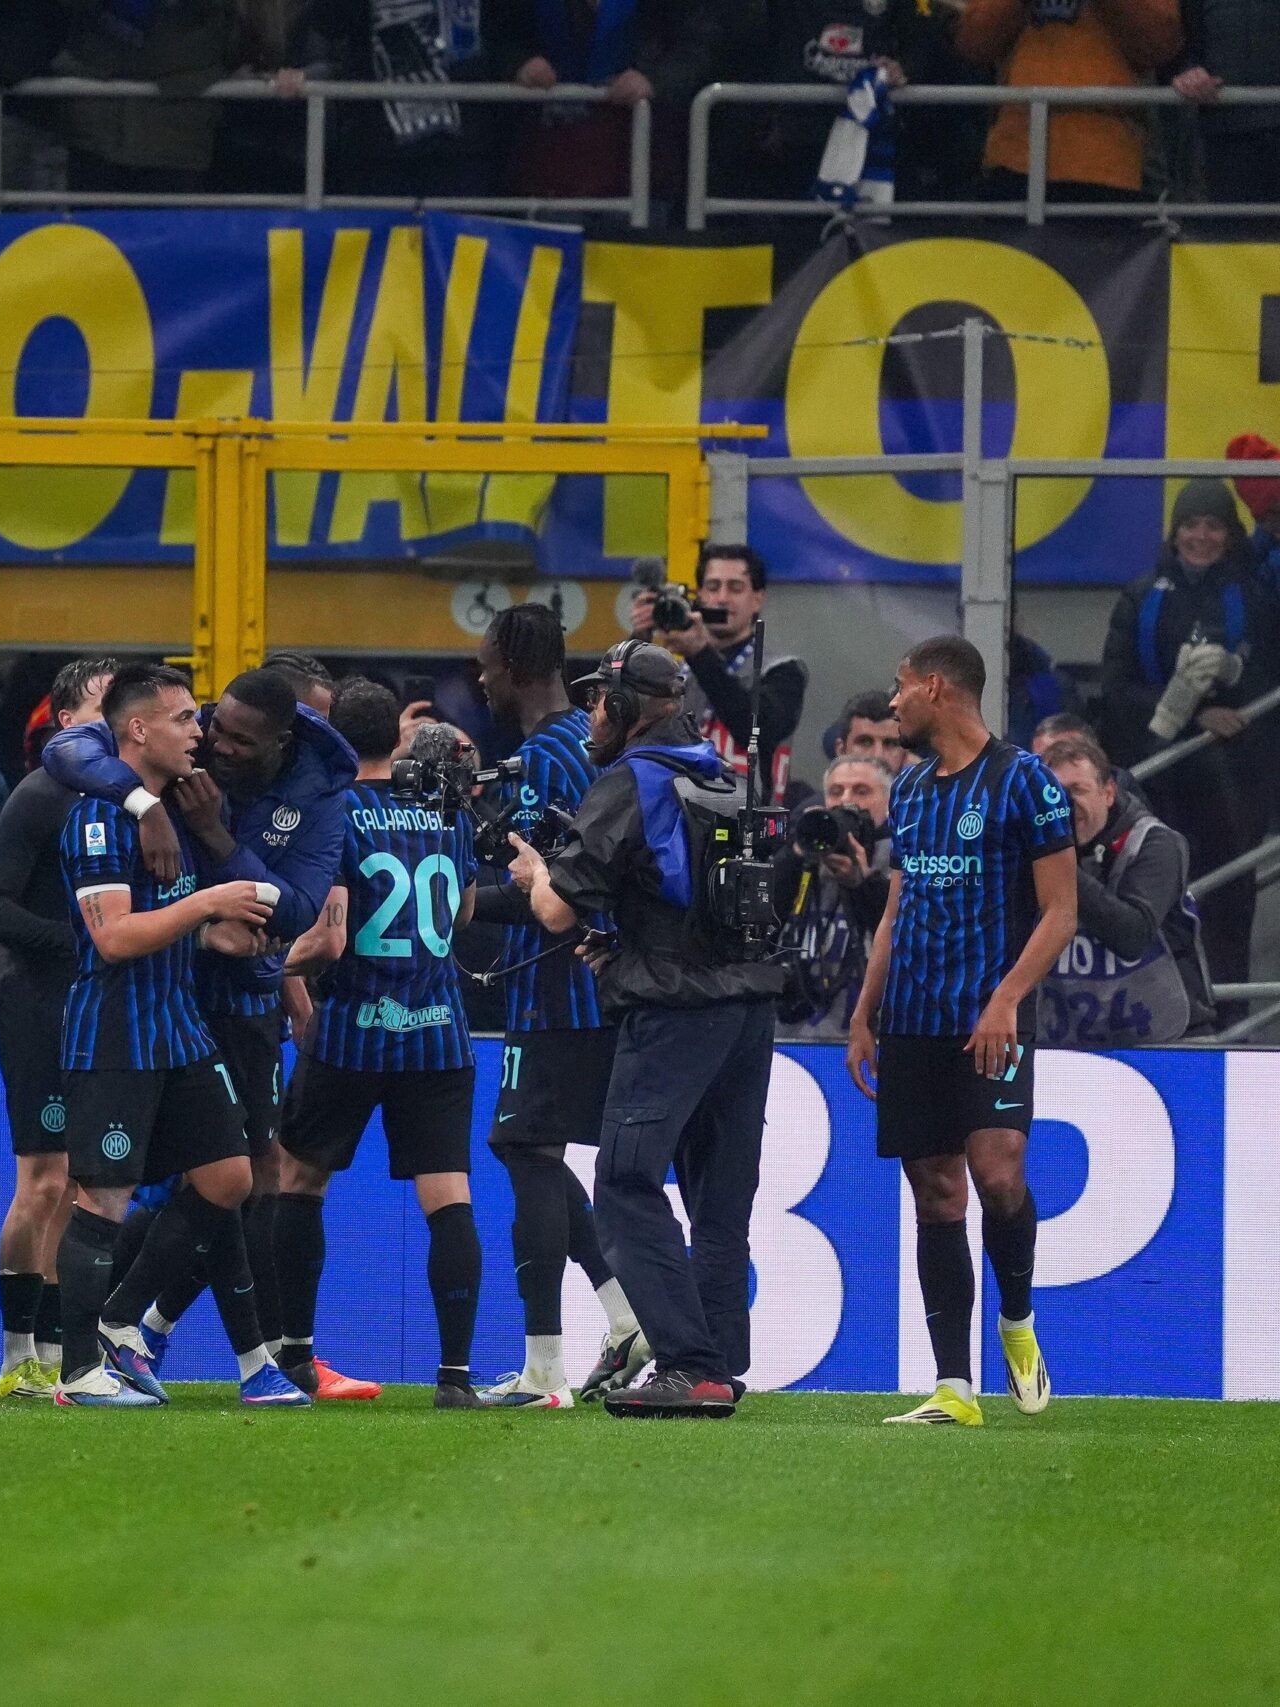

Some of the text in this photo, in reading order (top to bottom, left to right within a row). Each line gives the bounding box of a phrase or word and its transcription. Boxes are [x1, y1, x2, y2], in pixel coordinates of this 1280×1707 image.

[355, 851, 461, 959] 20
[213, 1063, 238, 1105] 1
[560, 1046, 1280, 1398] BP
